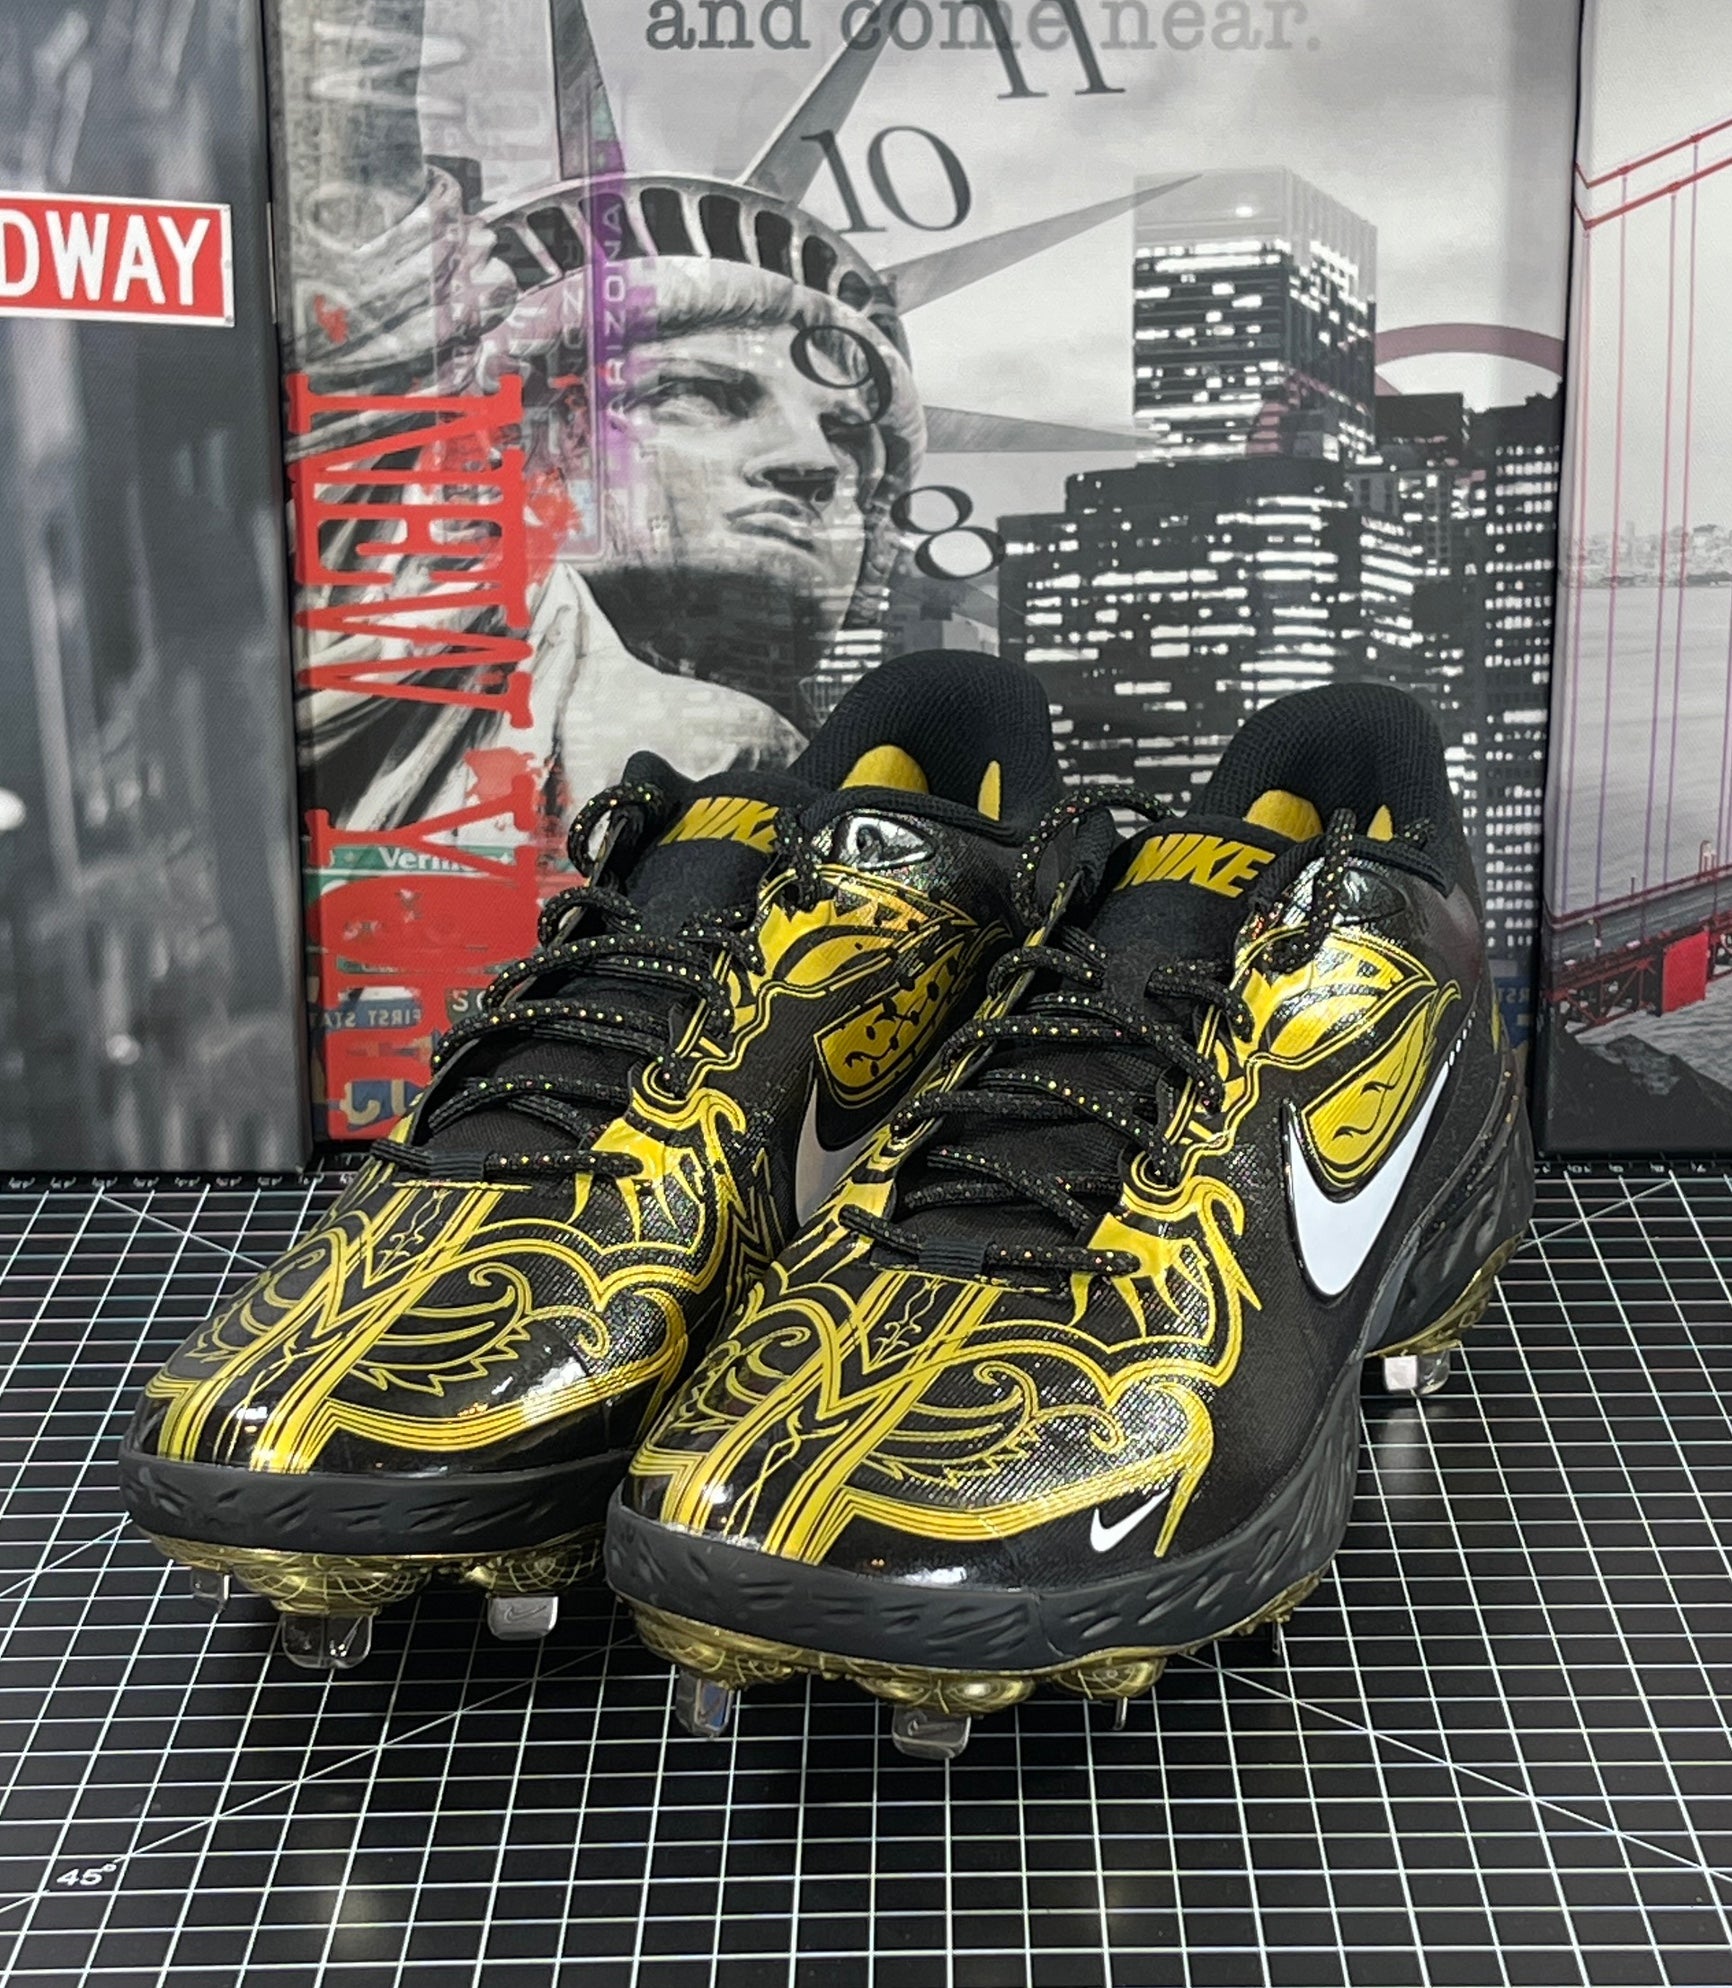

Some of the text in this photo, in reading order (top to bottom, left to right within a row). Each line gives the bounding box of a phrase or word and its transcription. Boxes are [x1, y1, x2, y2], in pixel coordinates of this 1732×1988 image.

[645, 0, 1321, 50] and come near.
[963, 0, 1126, 99] 11
[801, 126, 971, 231] 10
[0, 208, 210, 306] DWAY
[601, 203, 627, 424] ARIZONA
[790, 324, 893, 428] 9
[287, 373, 533, 729] NEW
[890, 485, 1007, 580] 8
[1113, 833, 1276, 898] NIKE
[57, 1863, 117, 1886] 45°
